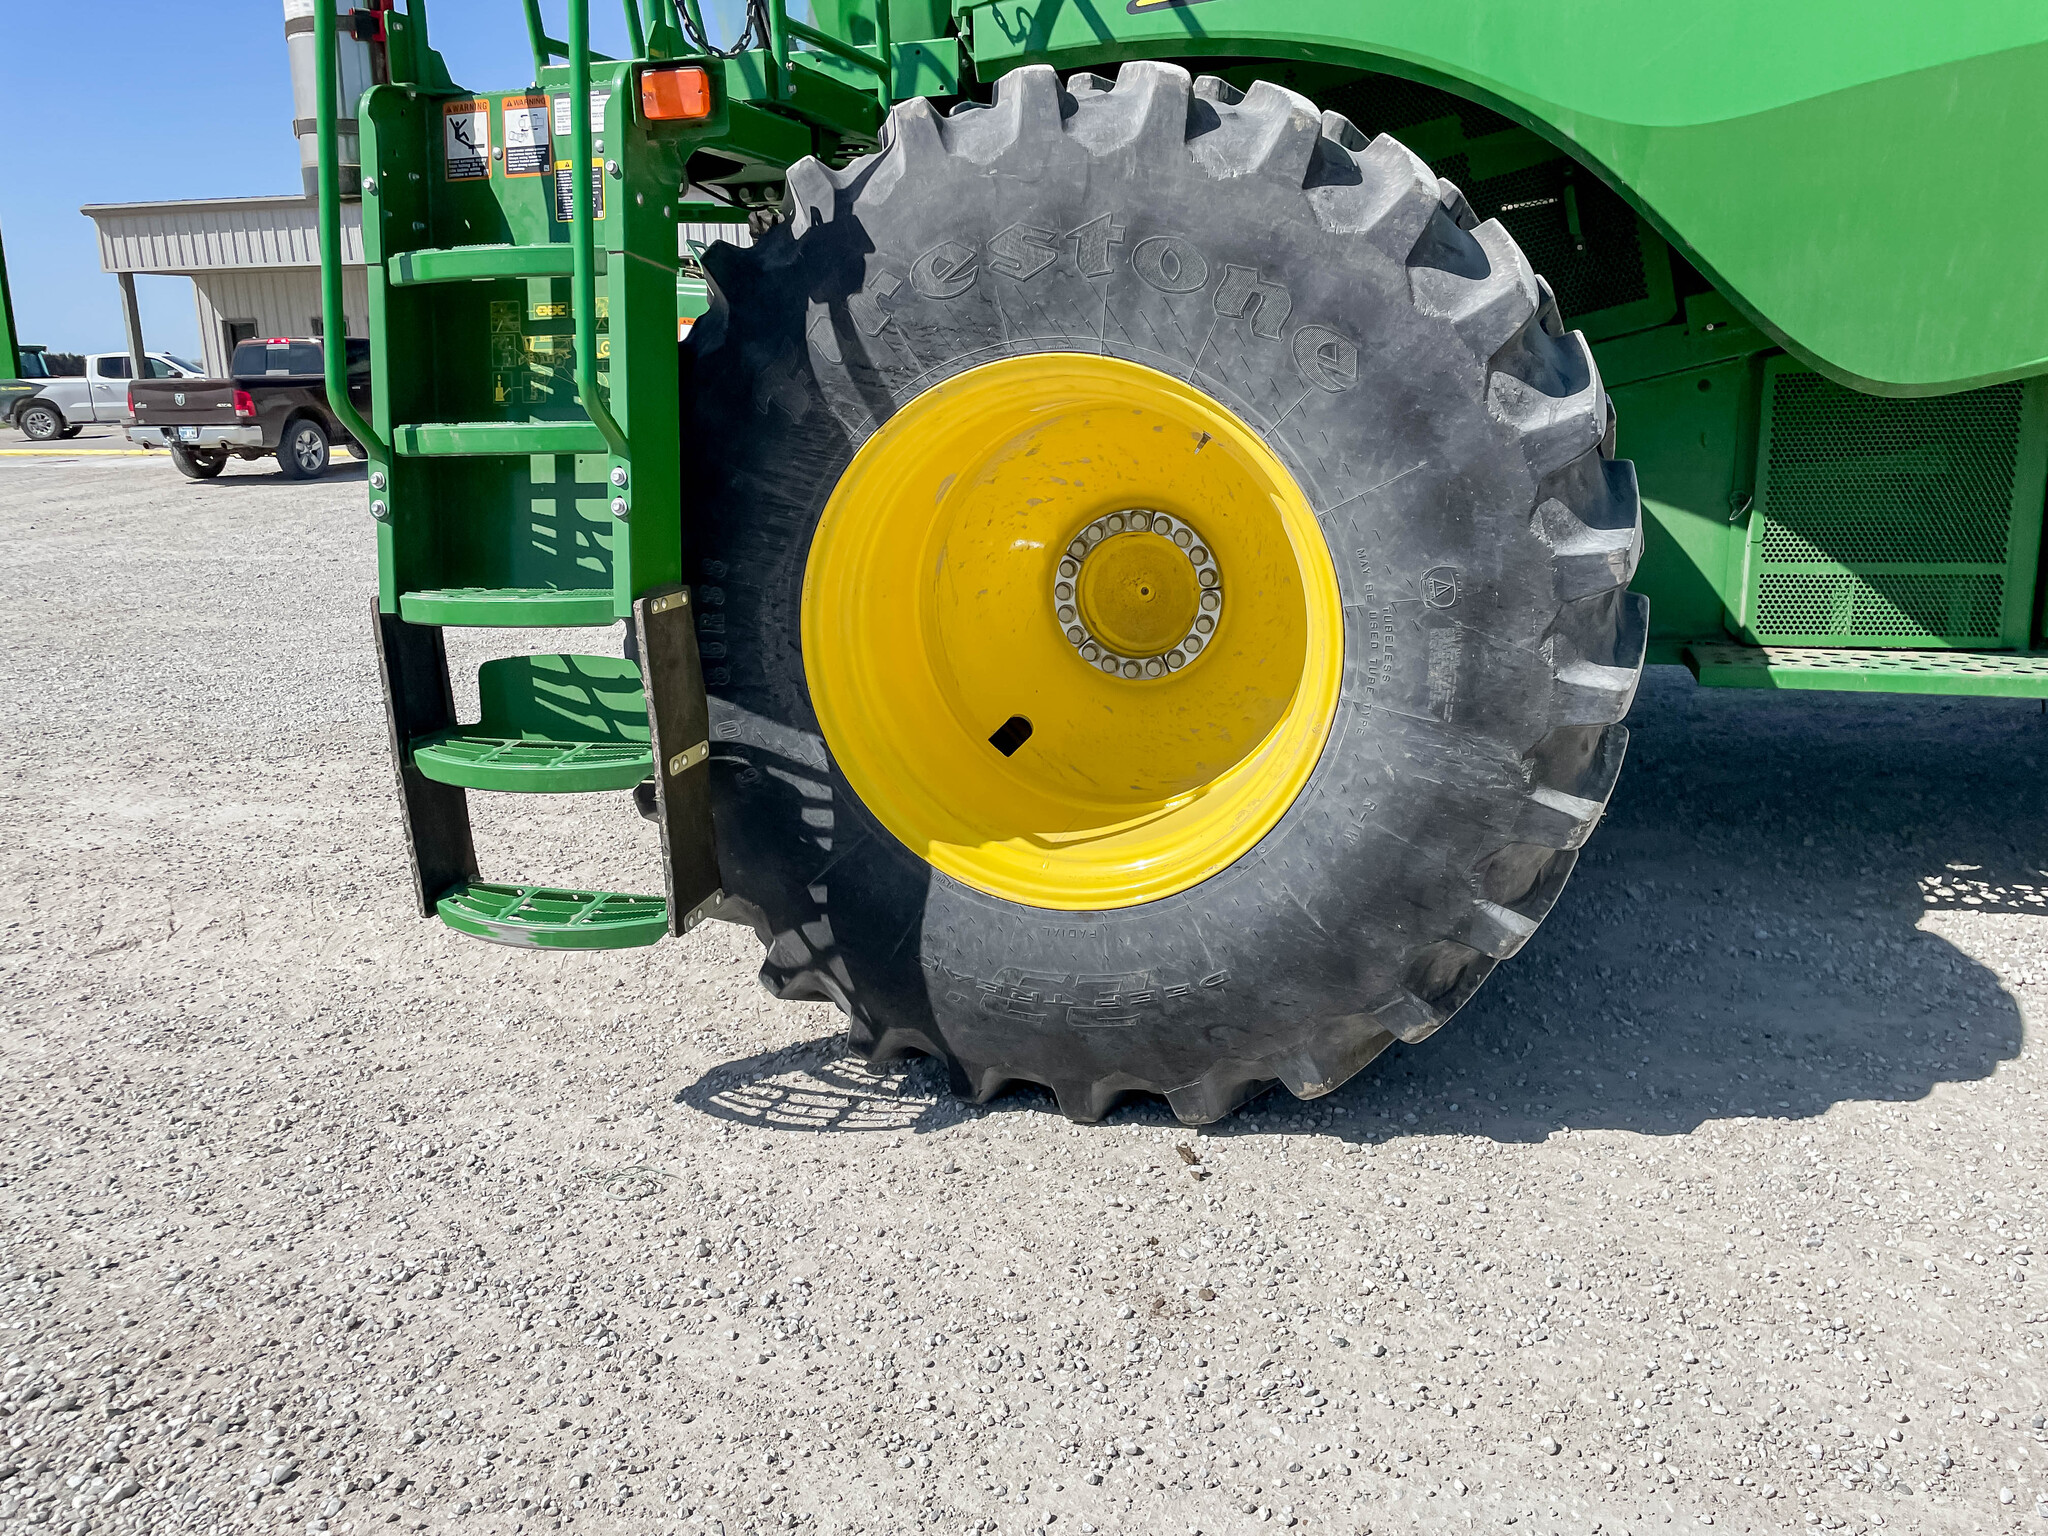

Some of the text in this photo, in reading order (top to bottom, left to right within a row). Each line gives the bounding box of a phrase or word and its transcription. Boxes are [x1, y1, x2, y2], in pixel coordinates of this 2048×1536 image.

[452, 102, 487, 113] WARNING
[513, 96, 546, 107] WARNING
[1356, 548, 1379, 736] MAY BE USED TUBE TYPE
[1382, 606, 1394, 683] TUBELESS
[1093, 968, 1231, 1007] DEEP
